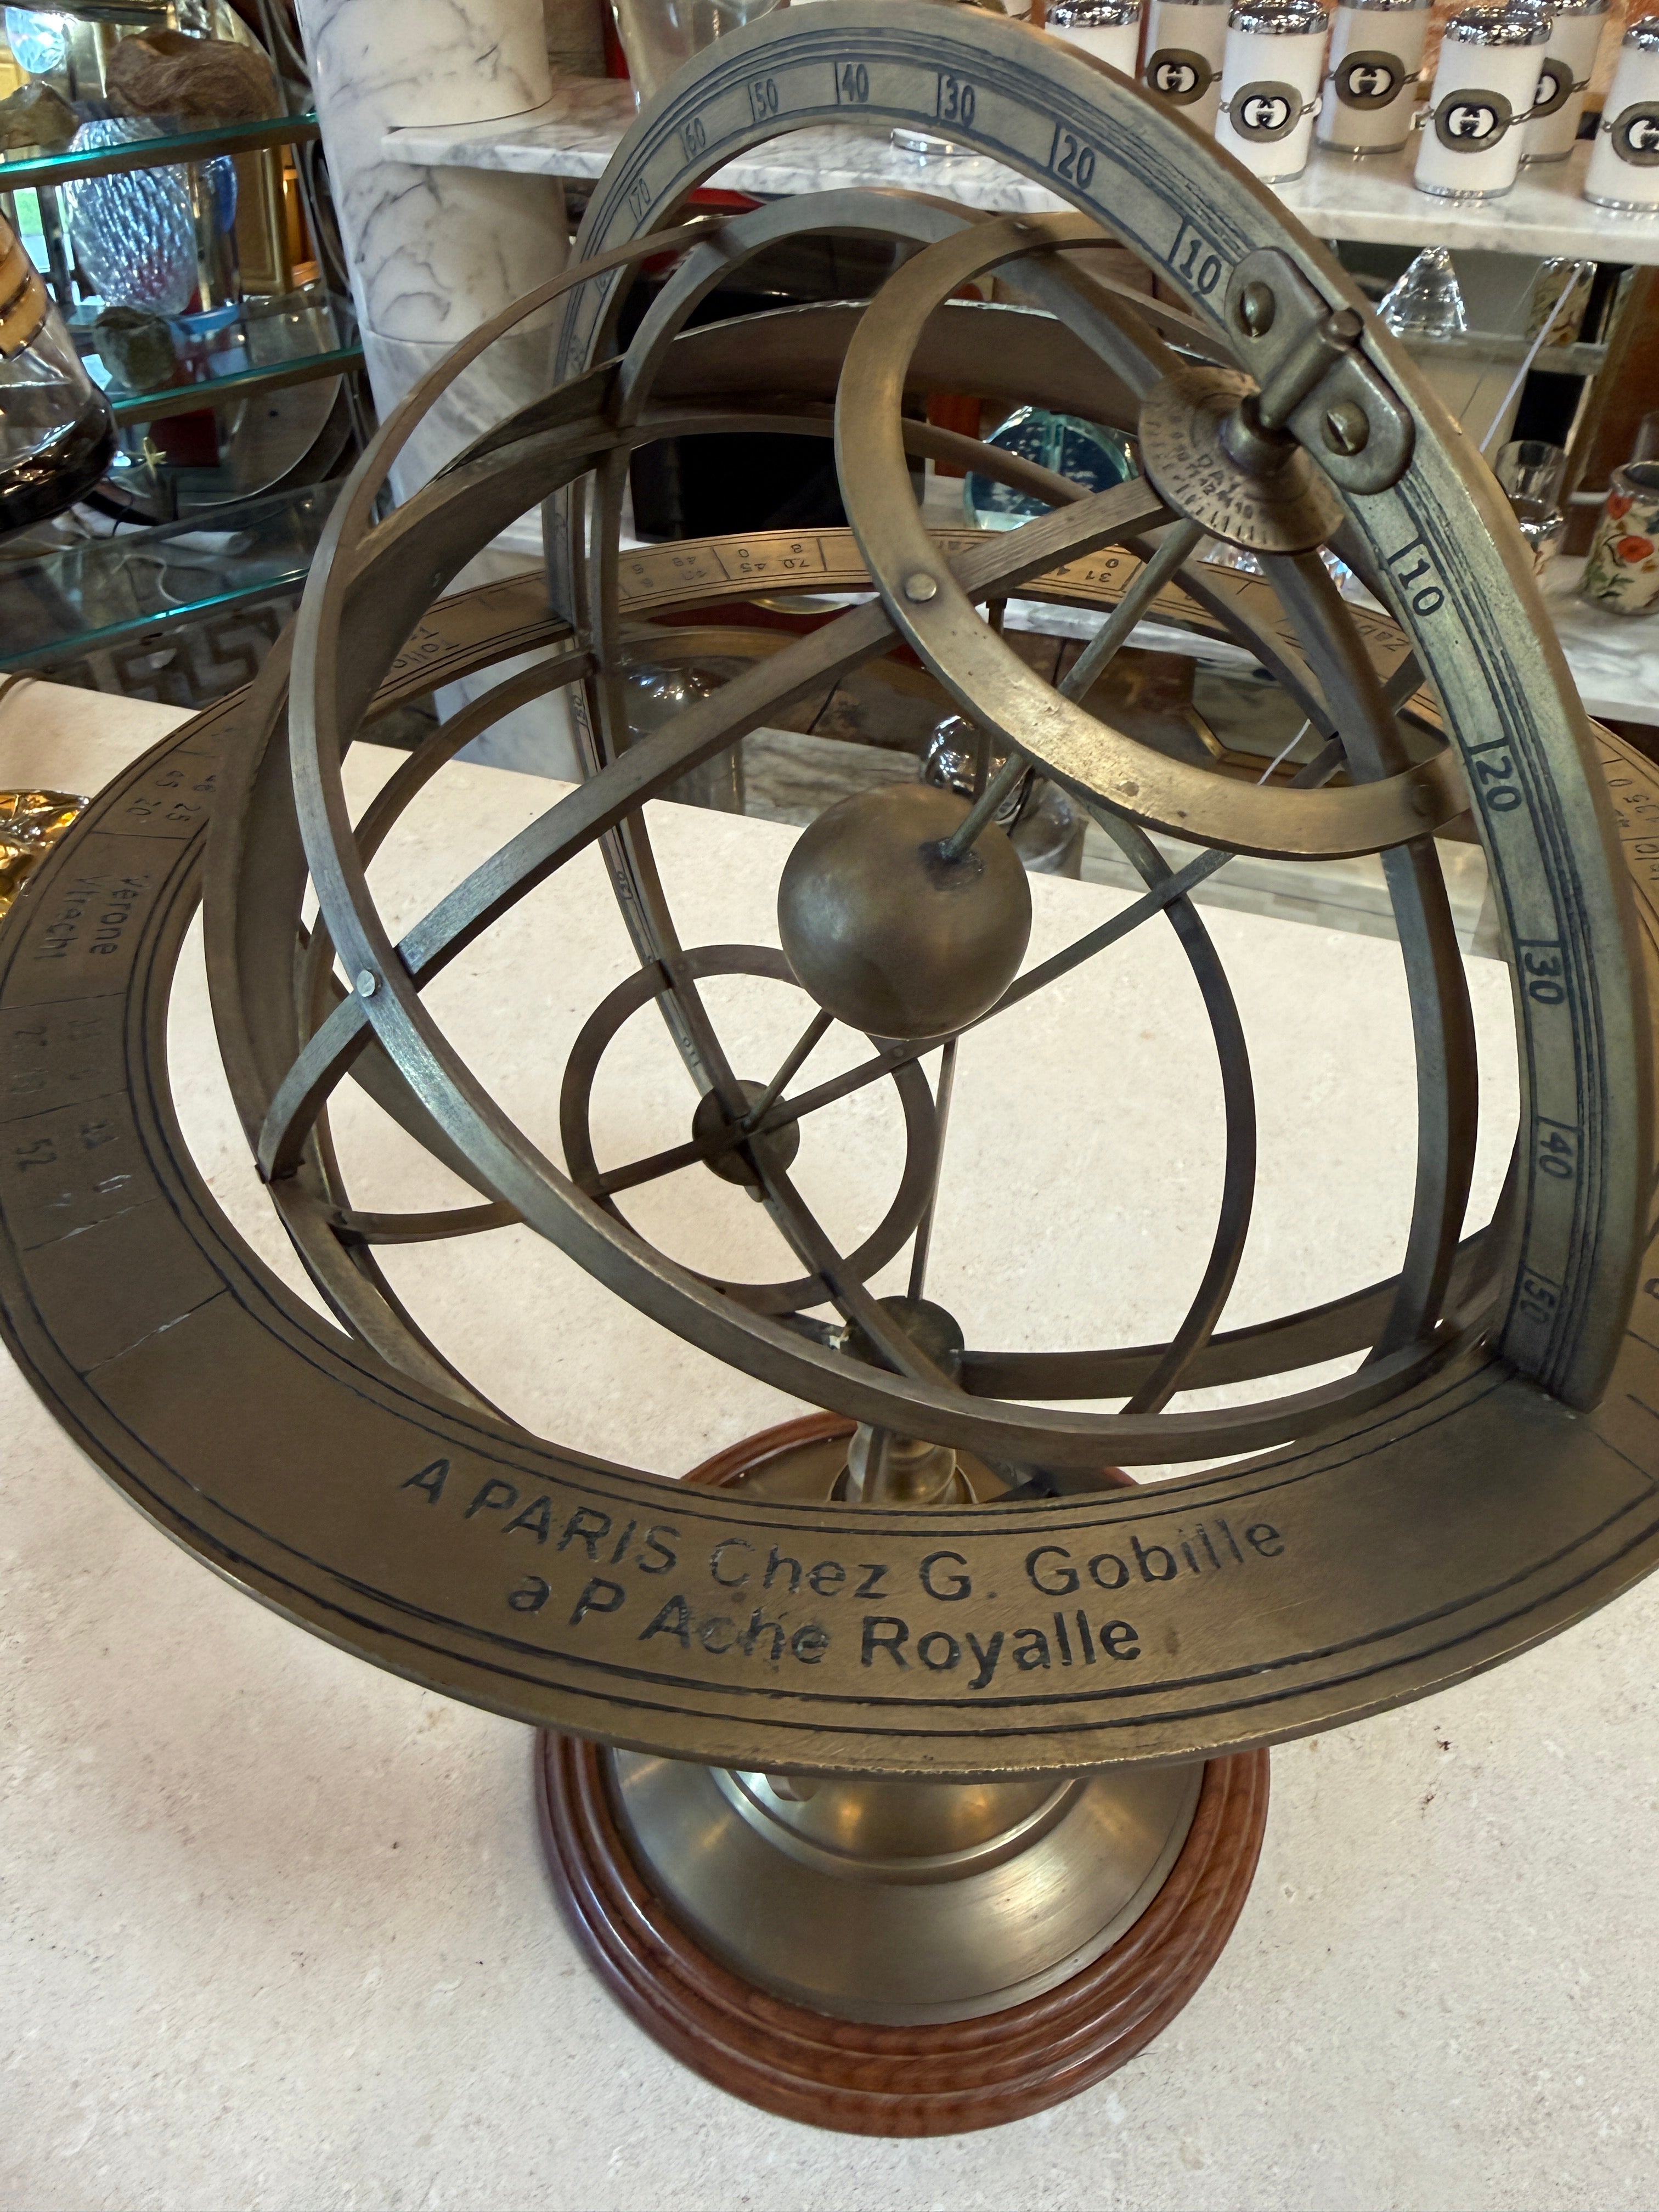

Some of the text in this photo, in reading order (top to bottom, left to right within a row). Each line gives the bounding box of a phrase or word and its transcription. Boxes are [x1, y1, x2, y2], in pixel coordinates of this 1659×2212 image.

[754, 78, 778, 117] 50
[842, 63, 870, 103] 40
[943, 75, 975, 129] 30
[1058, 135, 1095, 189] 20
[1179, 240, 1222, 295] 10
[1397, 558, 1445, 617] 10
[1476, 755, 1522, 813] 20
[1524, 951, 1565, 1006] 30
[1538, 1131, 1573, 1181] 40
[401, 1458, 1285, 1602] A PARIS Chez G. Gobille
[507, 1575, 551, 1613] a
[568, 1577, 626, 1626] P
[861, 1609, 1141, 1690] Royalle
